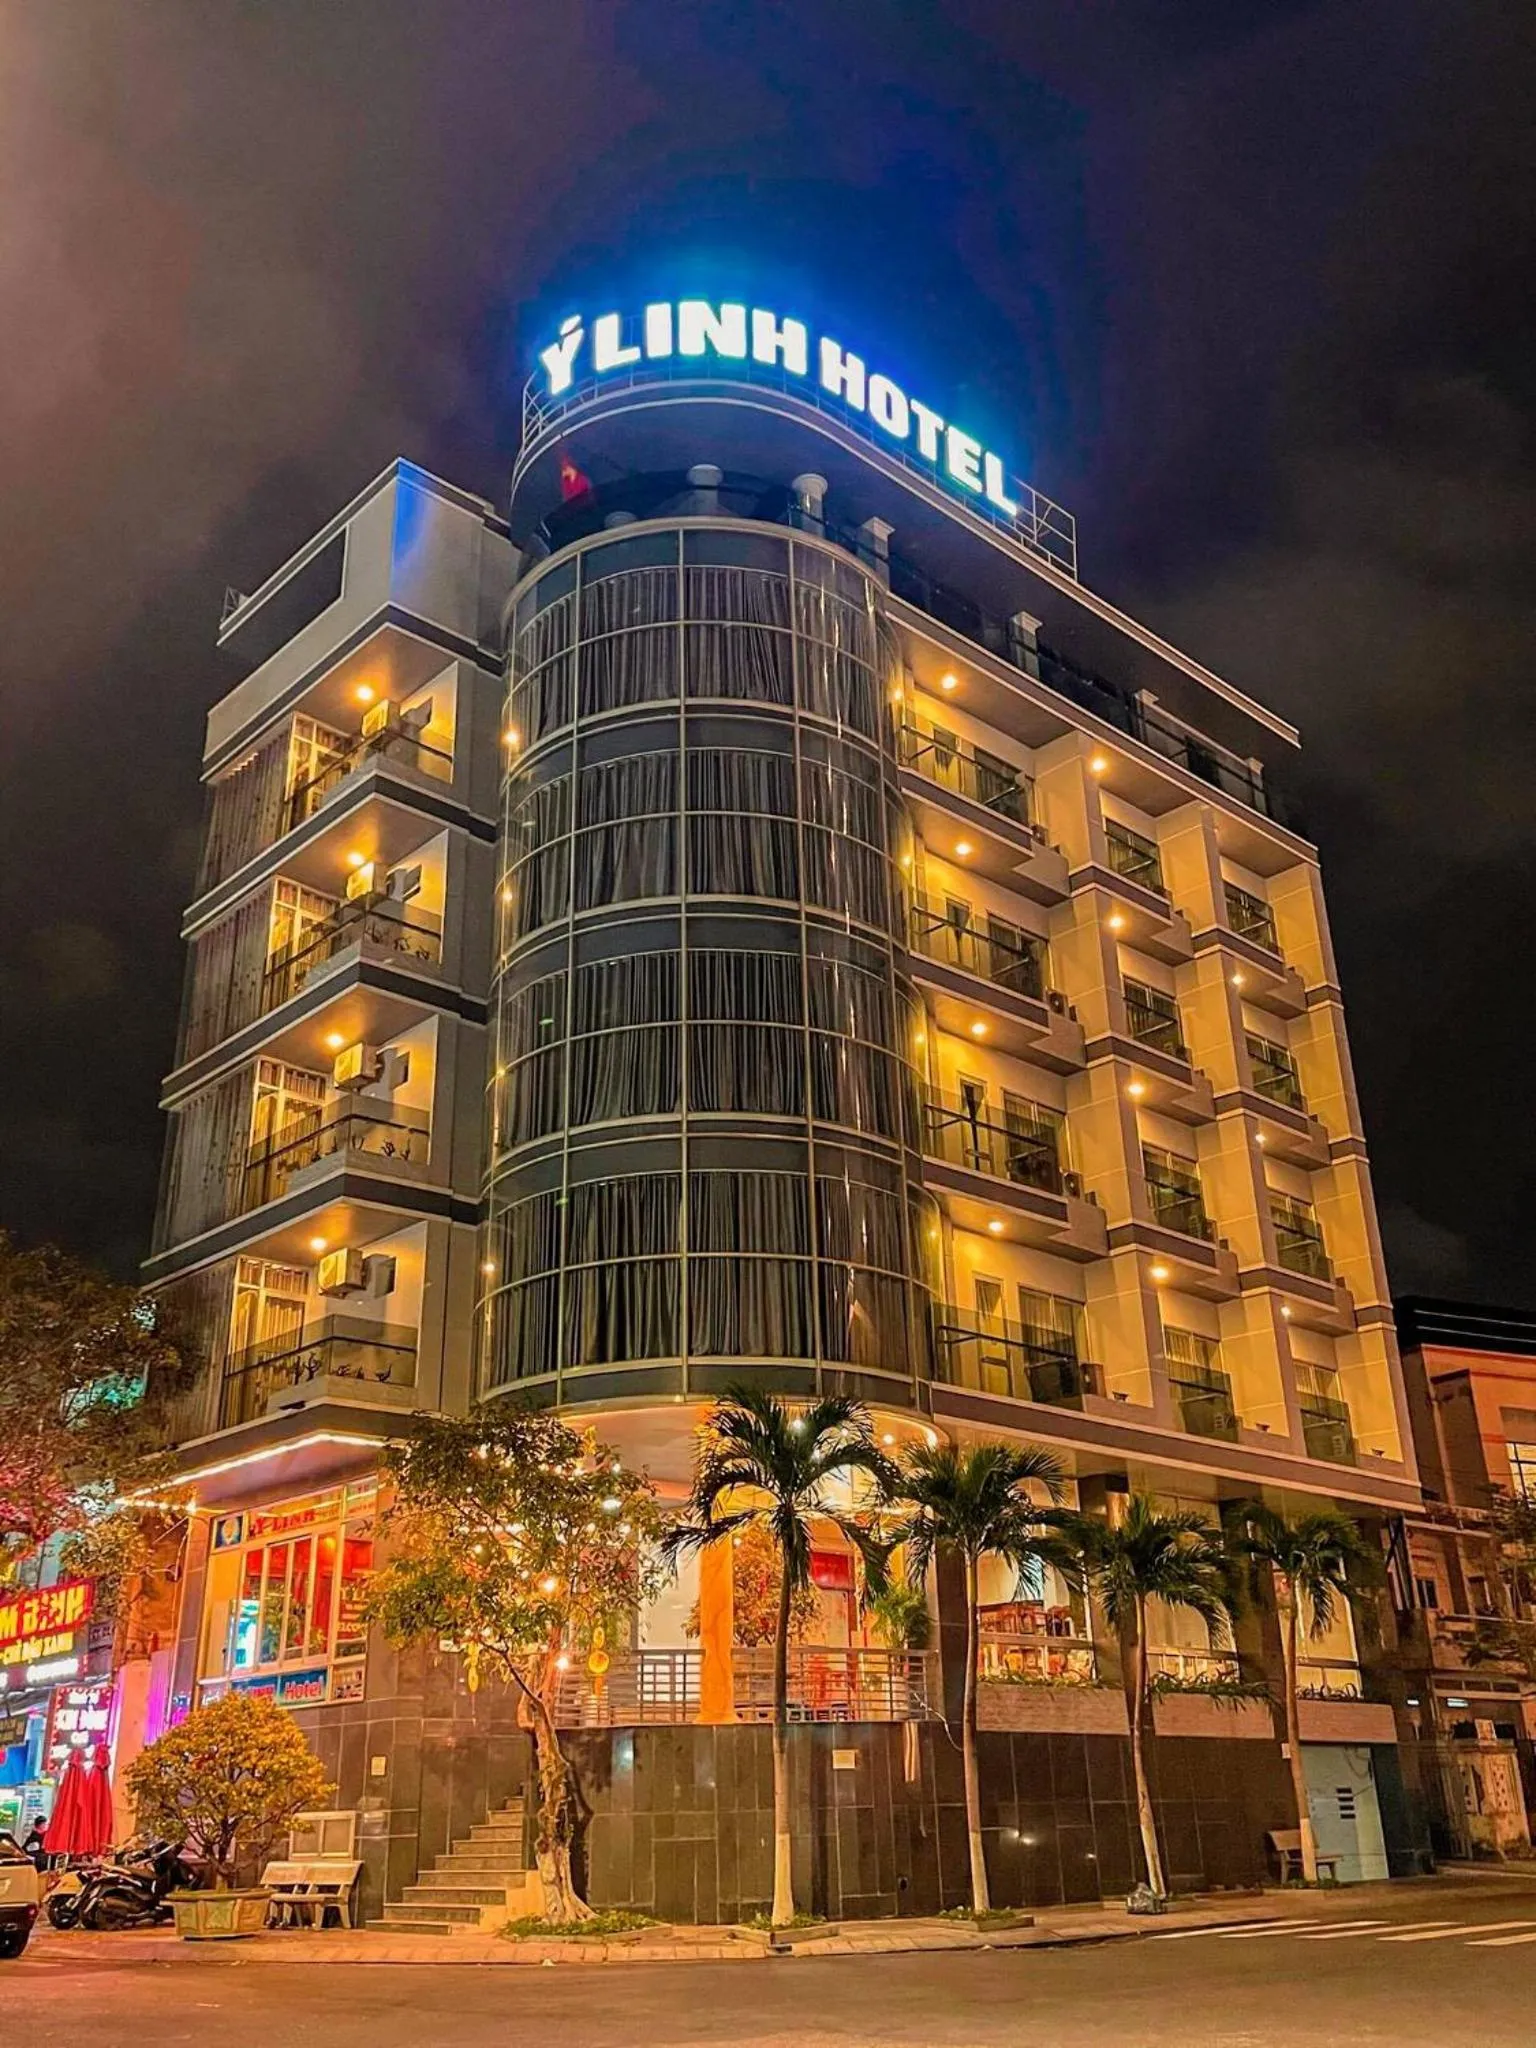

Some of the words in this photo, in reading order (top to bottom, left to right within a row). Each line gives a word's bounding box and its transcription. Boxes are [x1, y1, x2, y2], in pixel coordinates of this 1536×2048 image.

[541, 314, 583, 396] Ý
[595, 301, 807, 375] LINH
[819, 337, 1017, 516] HOTEL
[285, 1675, 323, 1699] Hotel
